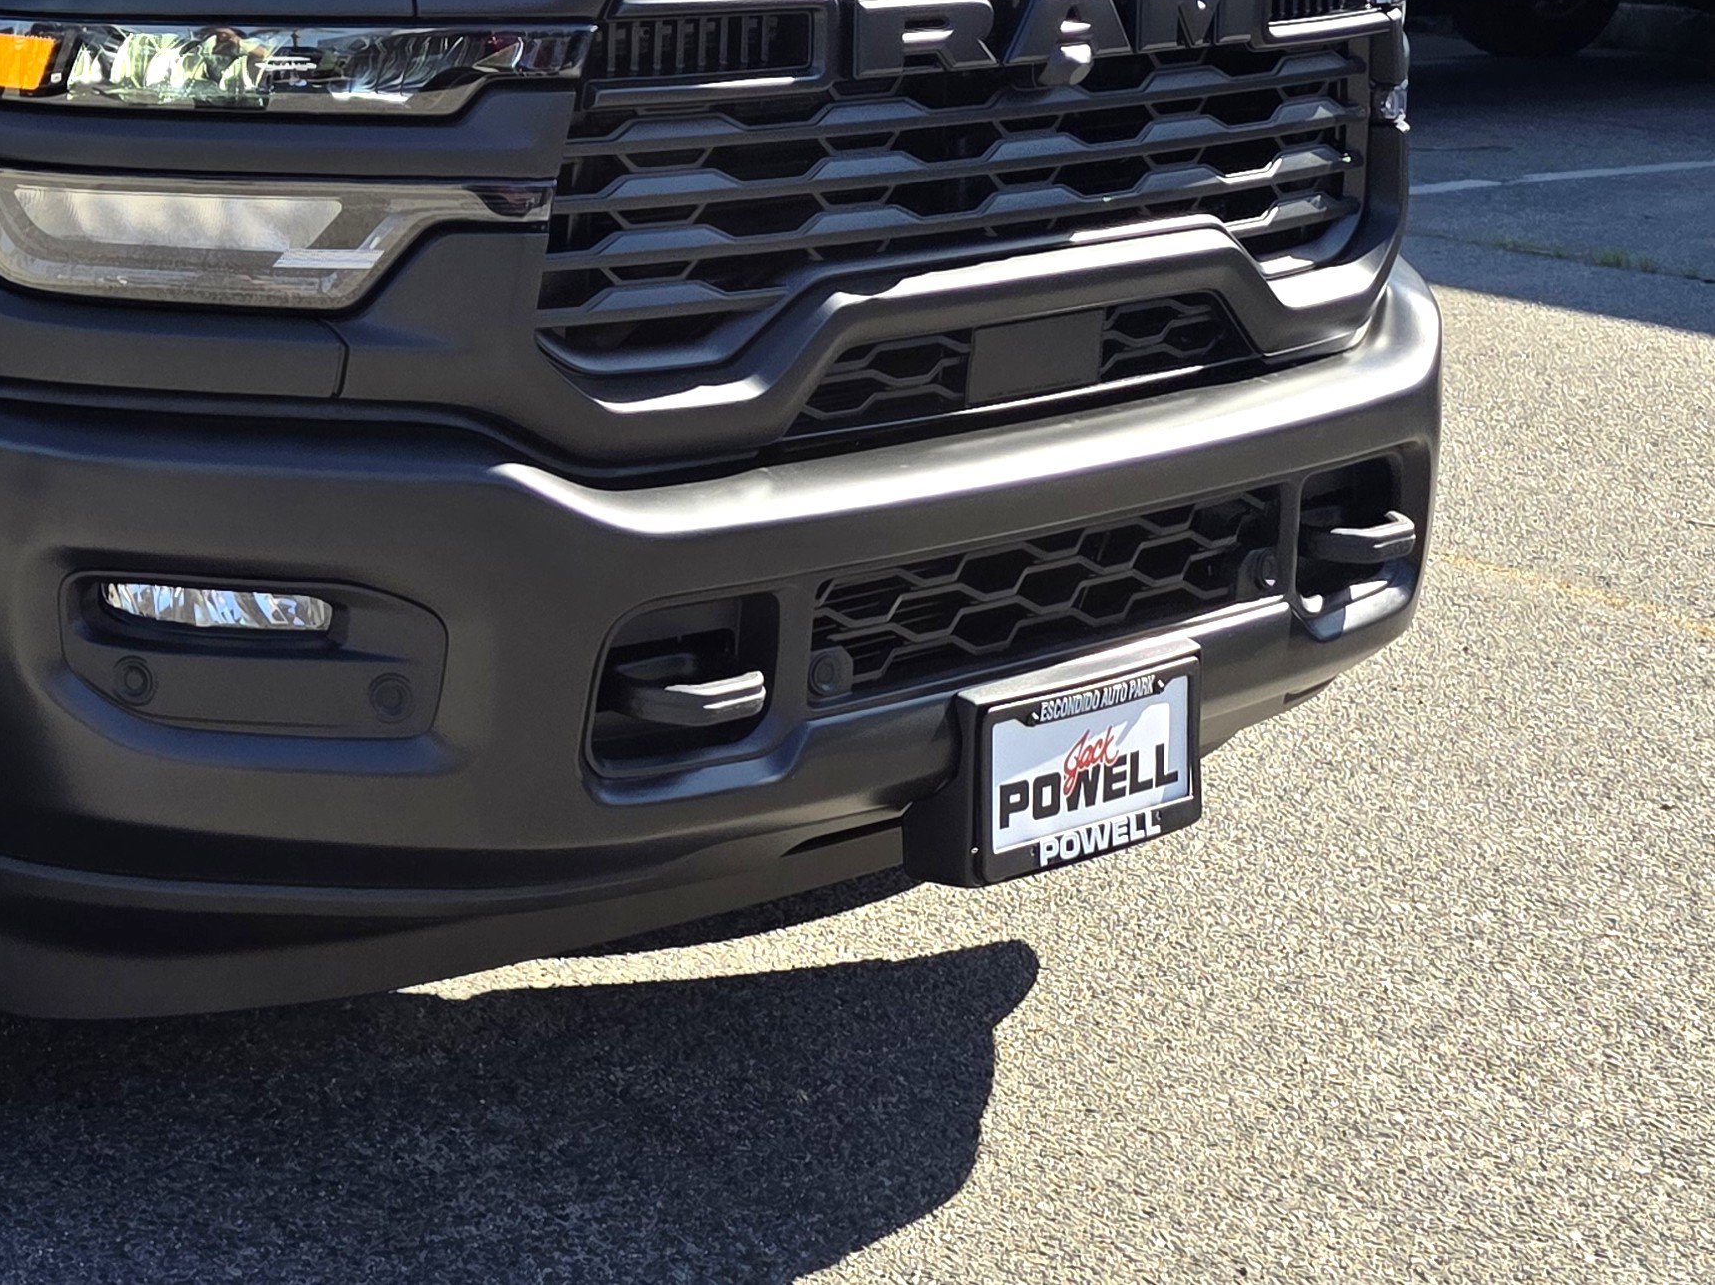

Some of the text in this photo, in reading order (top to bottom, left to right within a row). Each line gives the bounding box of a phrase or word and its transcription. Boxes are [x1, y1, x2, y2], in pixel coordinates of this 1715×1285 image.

[1039, 674, 1156, 722] ESCONDIDO AUTO PARK
[999, 743, 1179, 830] POWELL
[1063, 725, 1120, 796] Jack
[1039, 810, 1162, 868] POWELL
